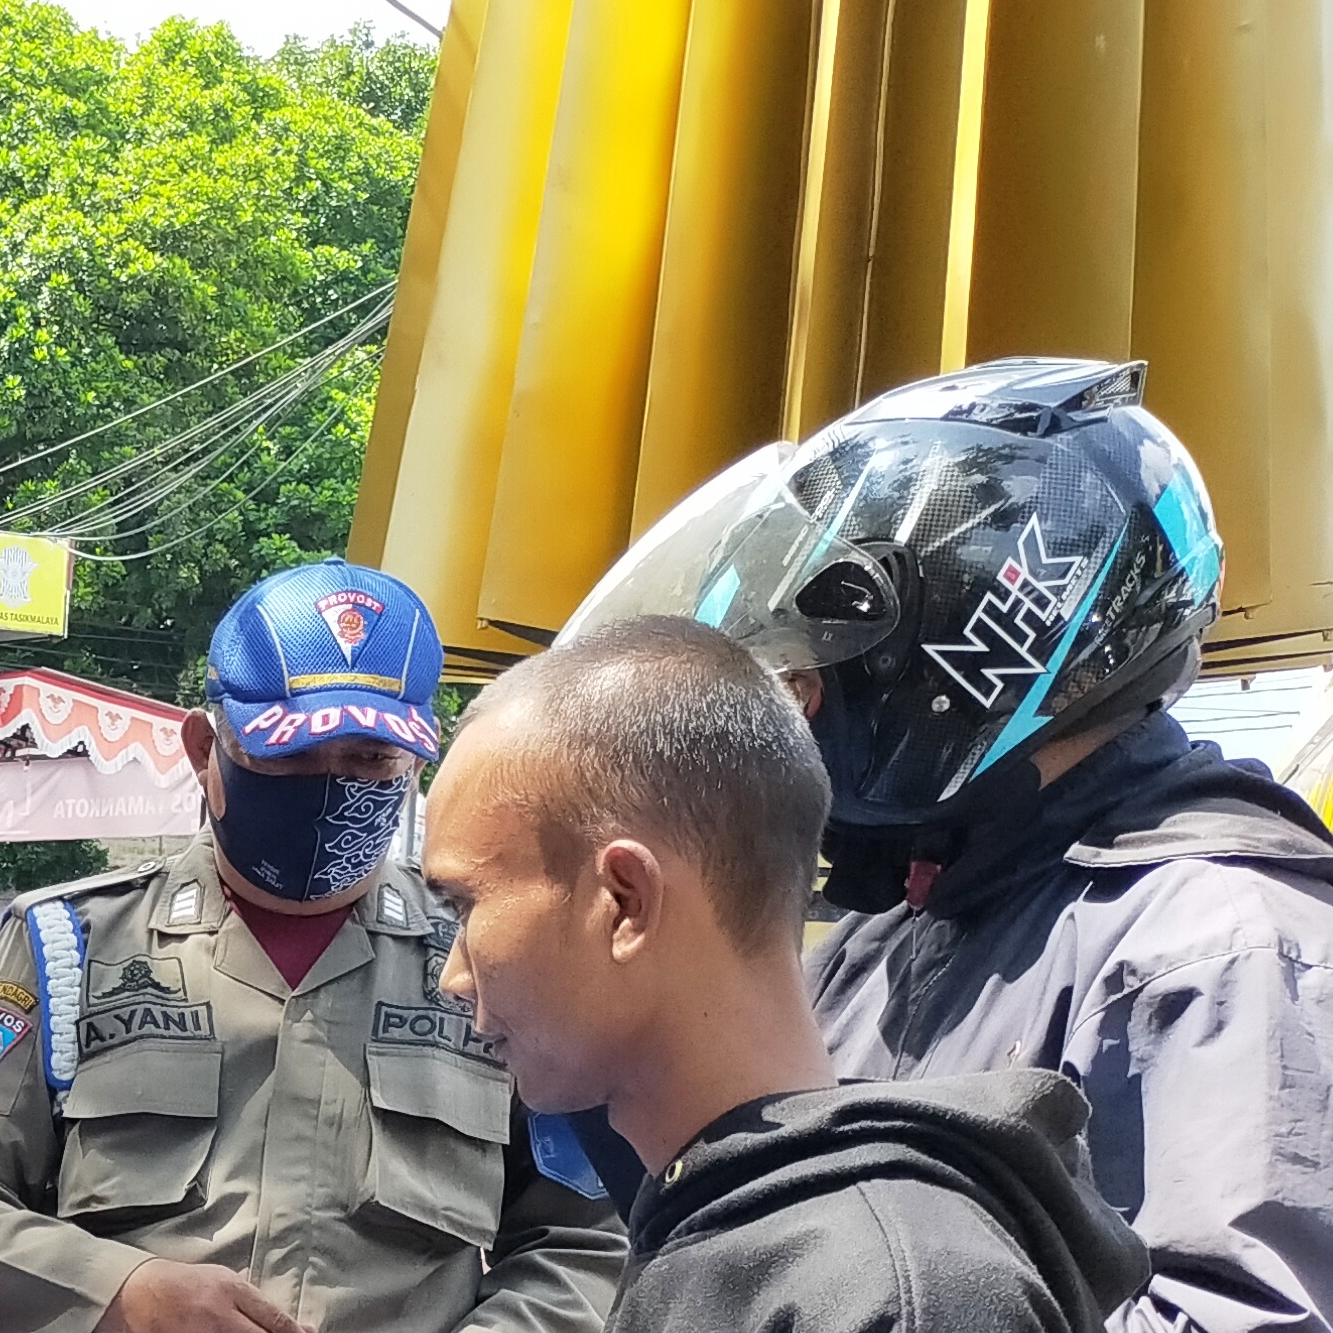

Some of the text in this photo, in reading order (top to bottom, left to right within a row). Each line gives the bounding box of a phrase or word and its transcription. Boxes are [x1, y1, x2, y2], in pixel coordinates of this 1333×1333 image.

[318, 591, 381, 612] PROVOST
[921, 512, 1085, 709] NHK
[9, 612, 60, 626] TASIKMALAYA
